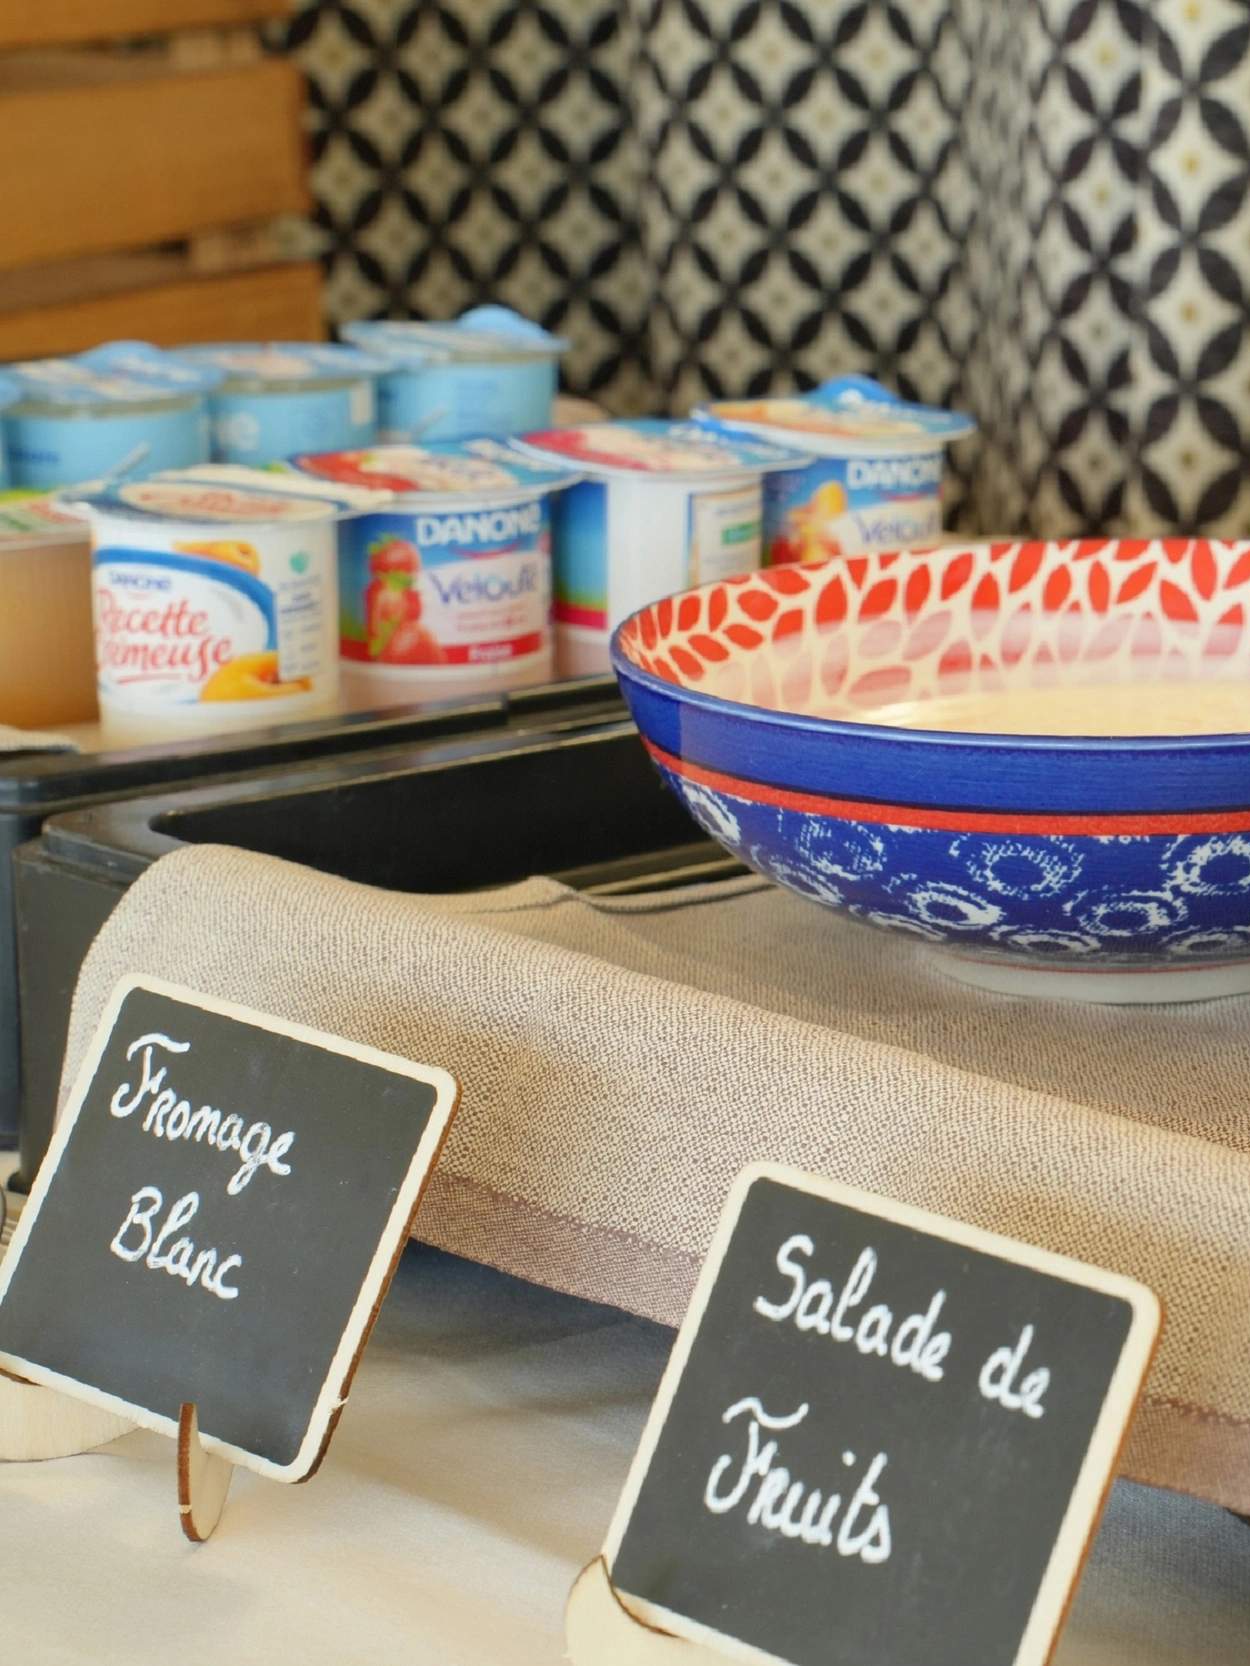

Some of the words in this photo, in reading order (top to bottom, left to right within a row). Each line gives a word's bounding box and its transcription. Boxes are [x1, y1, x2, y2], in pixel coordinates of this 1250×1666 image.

[110, 1186, 242, 1299] Blanc
[754, 1234, 952, 1381] Salade
[979, 1324, 1050, 1419] de
[704, 1397, 892, 1564] Fruits
